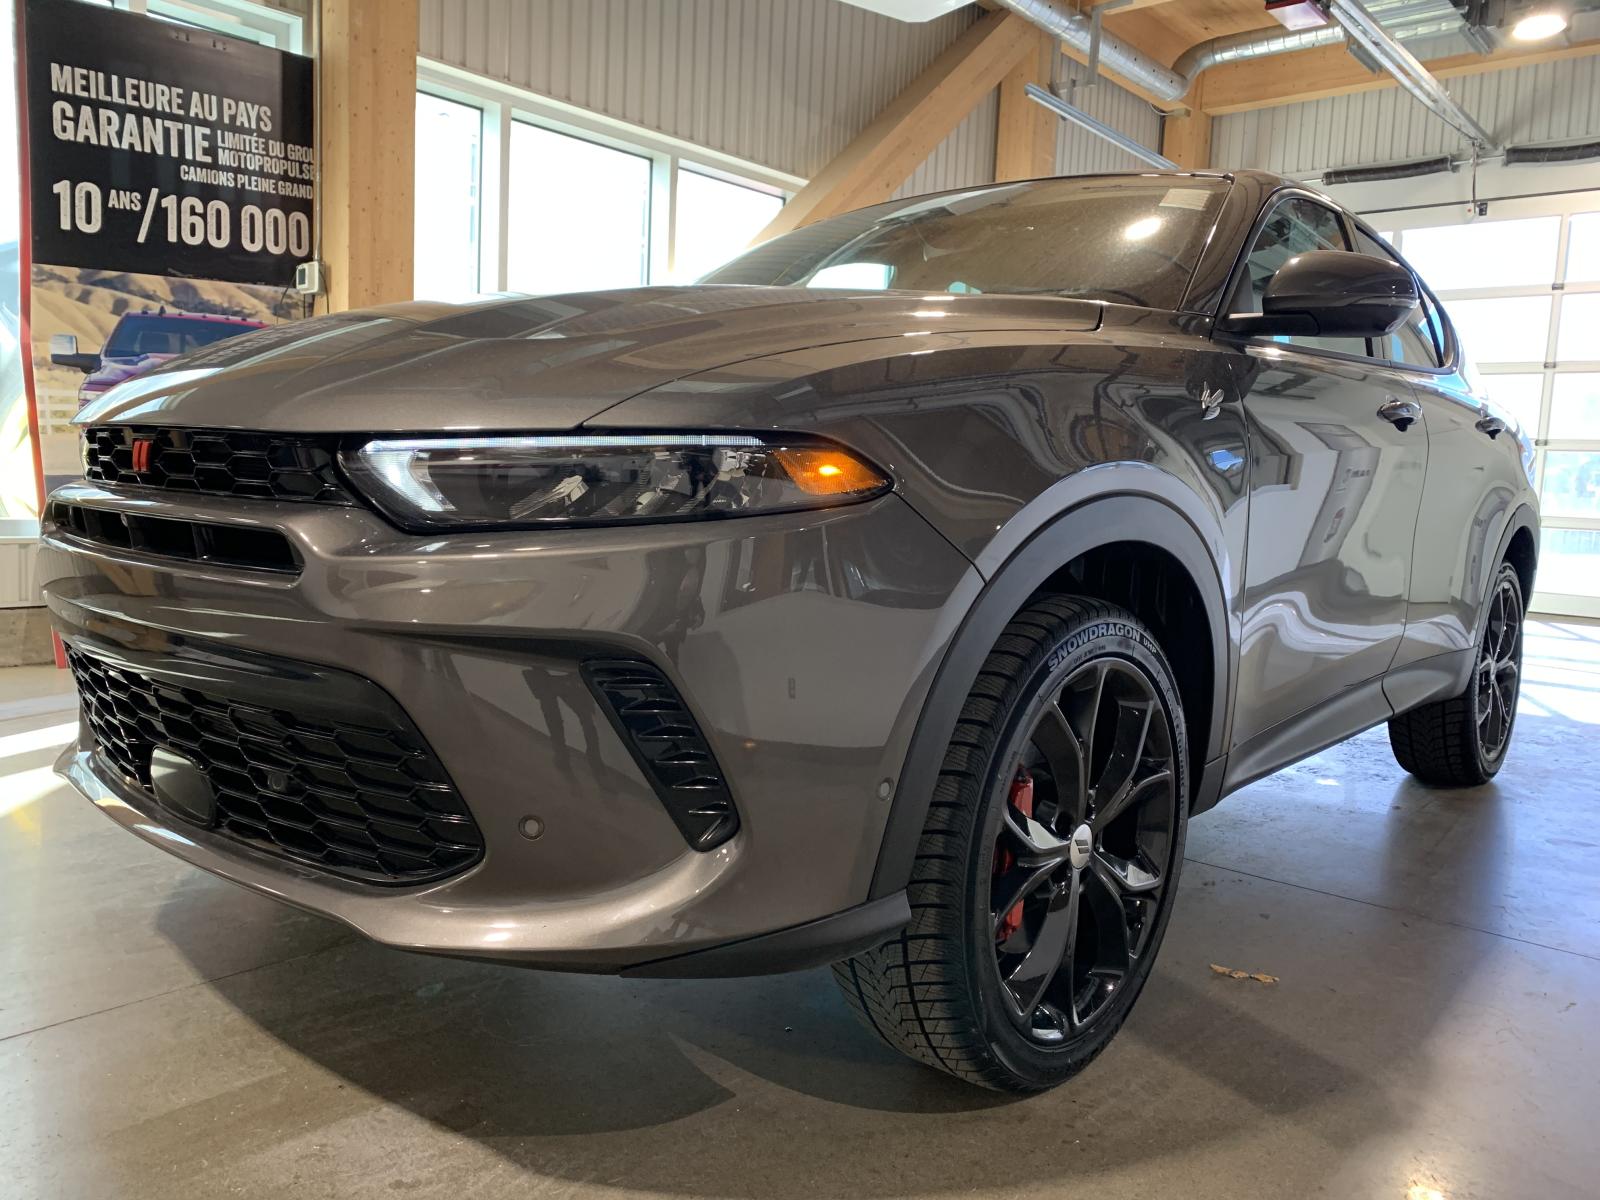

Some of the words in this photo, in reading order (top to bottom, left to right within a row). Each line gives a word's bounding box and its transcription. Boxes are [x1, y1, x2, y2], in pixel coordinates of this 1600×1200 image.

[50, 62, 185, 116] MEILLEURE
[189, 90, 218, 122] AU
[222, 97, 272, 133] PAYS
[52, 100, 212, 164] GARANTIE
[217, 129, 267, 155] LIMITÉE
[268, 139, 285, 158] DU
[180, 164, 235, 188] CAMIONS
[236, 173, 277, 195] PLEINE
[277, 180, 313, 200] GRAND
[52, 180, 102, 234] 10
[107, 189, 142, 212] ANS
[240, 204, 310, 258] 000
[1047, 622, 1141, 673] SNOWDRAGON
